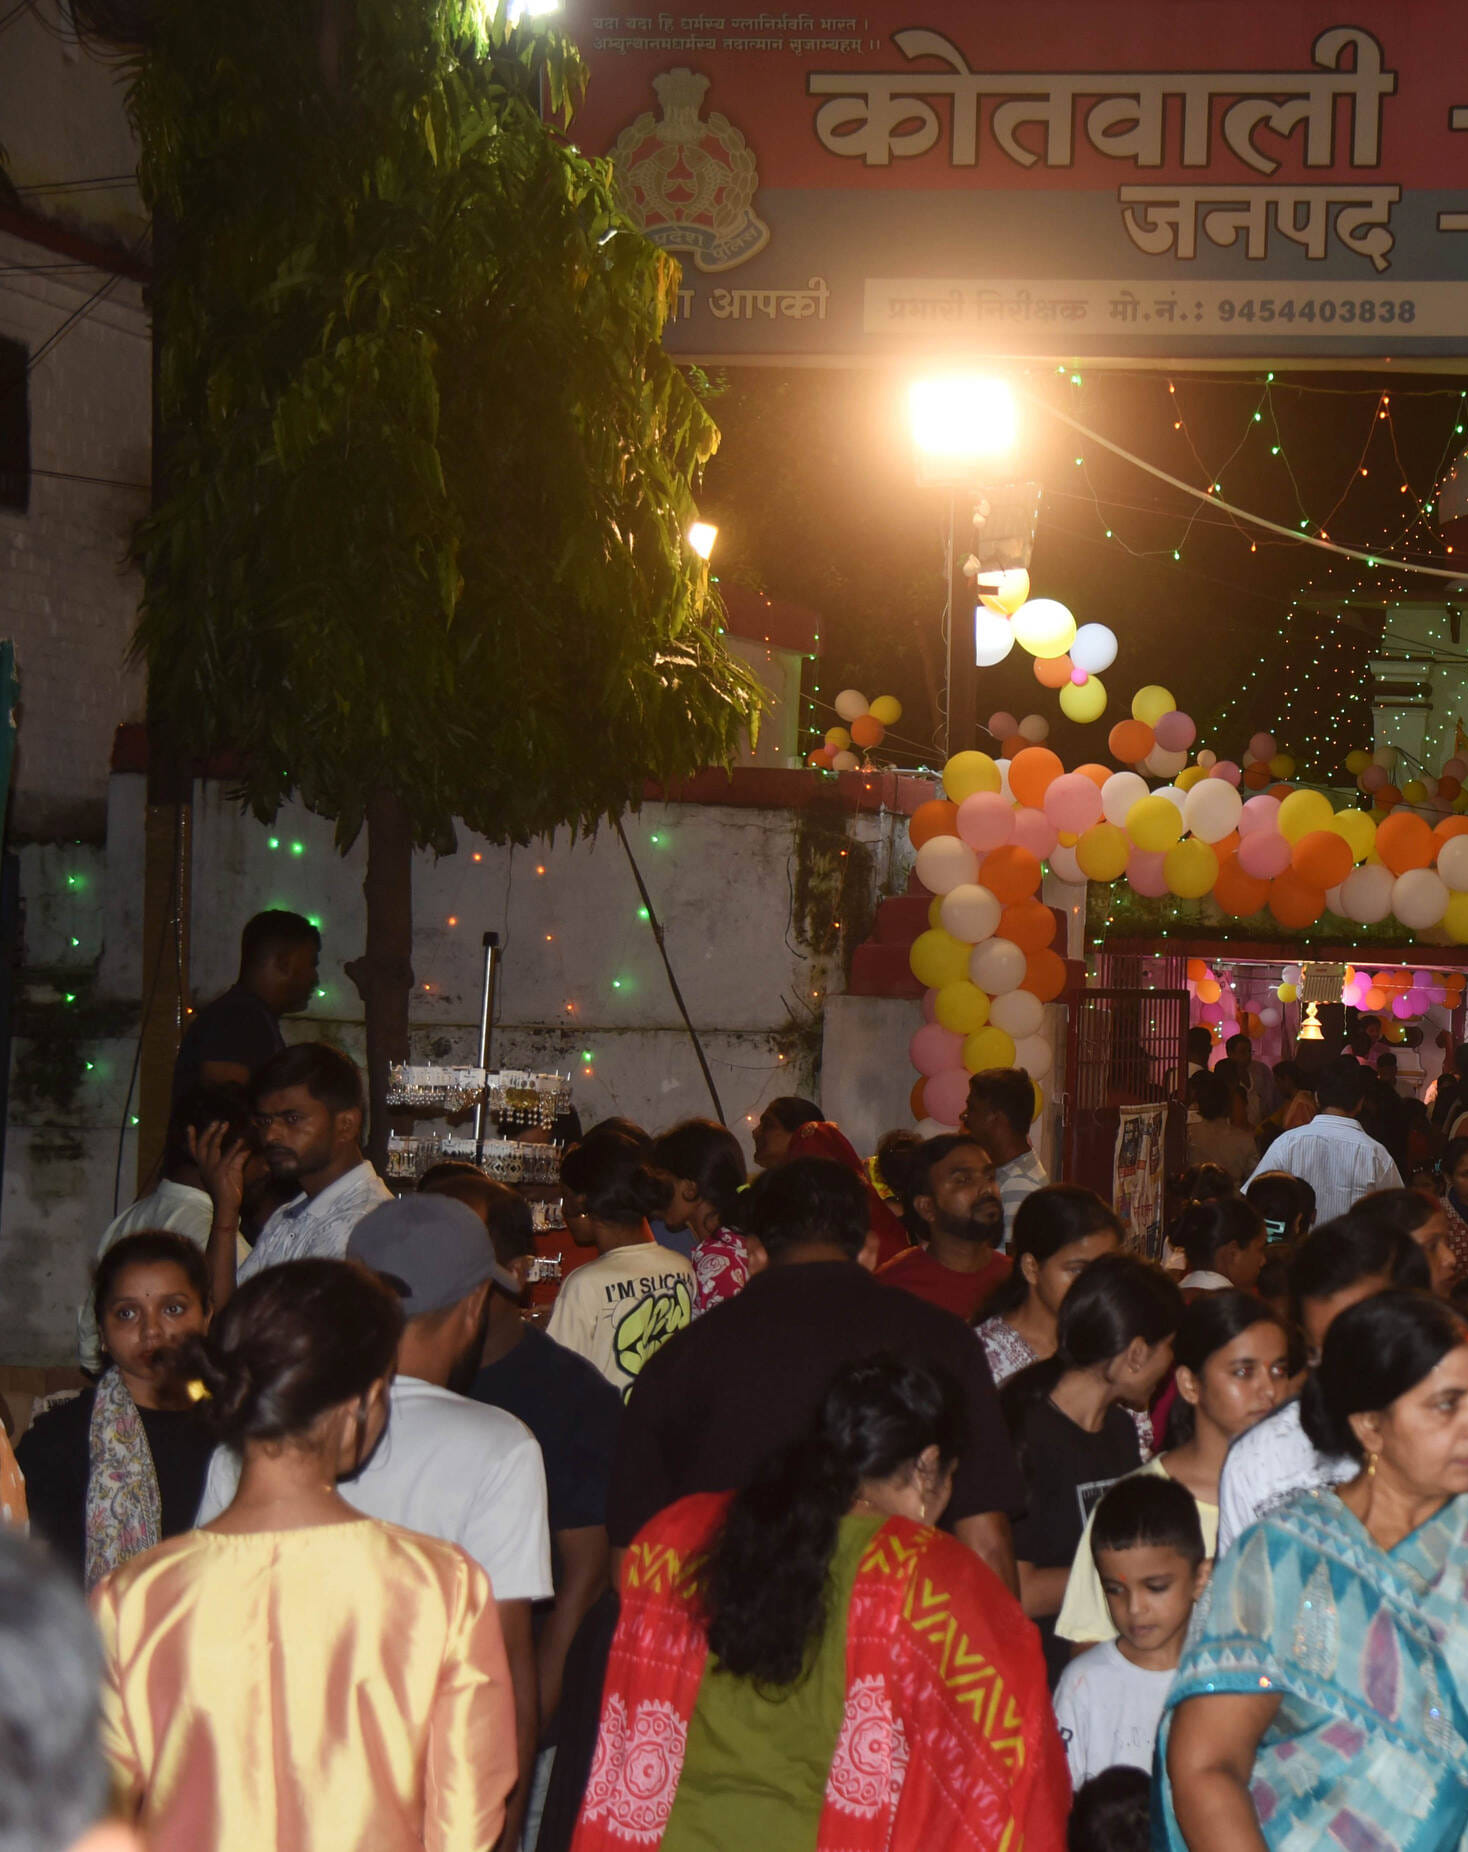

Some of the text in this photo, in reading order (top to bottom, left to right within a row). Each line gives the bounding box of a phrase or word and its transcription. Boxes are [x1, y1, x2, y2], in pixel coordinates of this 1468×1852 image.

[806, 26, 1398, 177] कोतवाली
[1118, 184, 1402, 274] जनपद
[708, 276, 830, 320] आपकी
[1217, 299, 1417, 324] 9454403838
[605, 1279, 636, 1303] I'M
